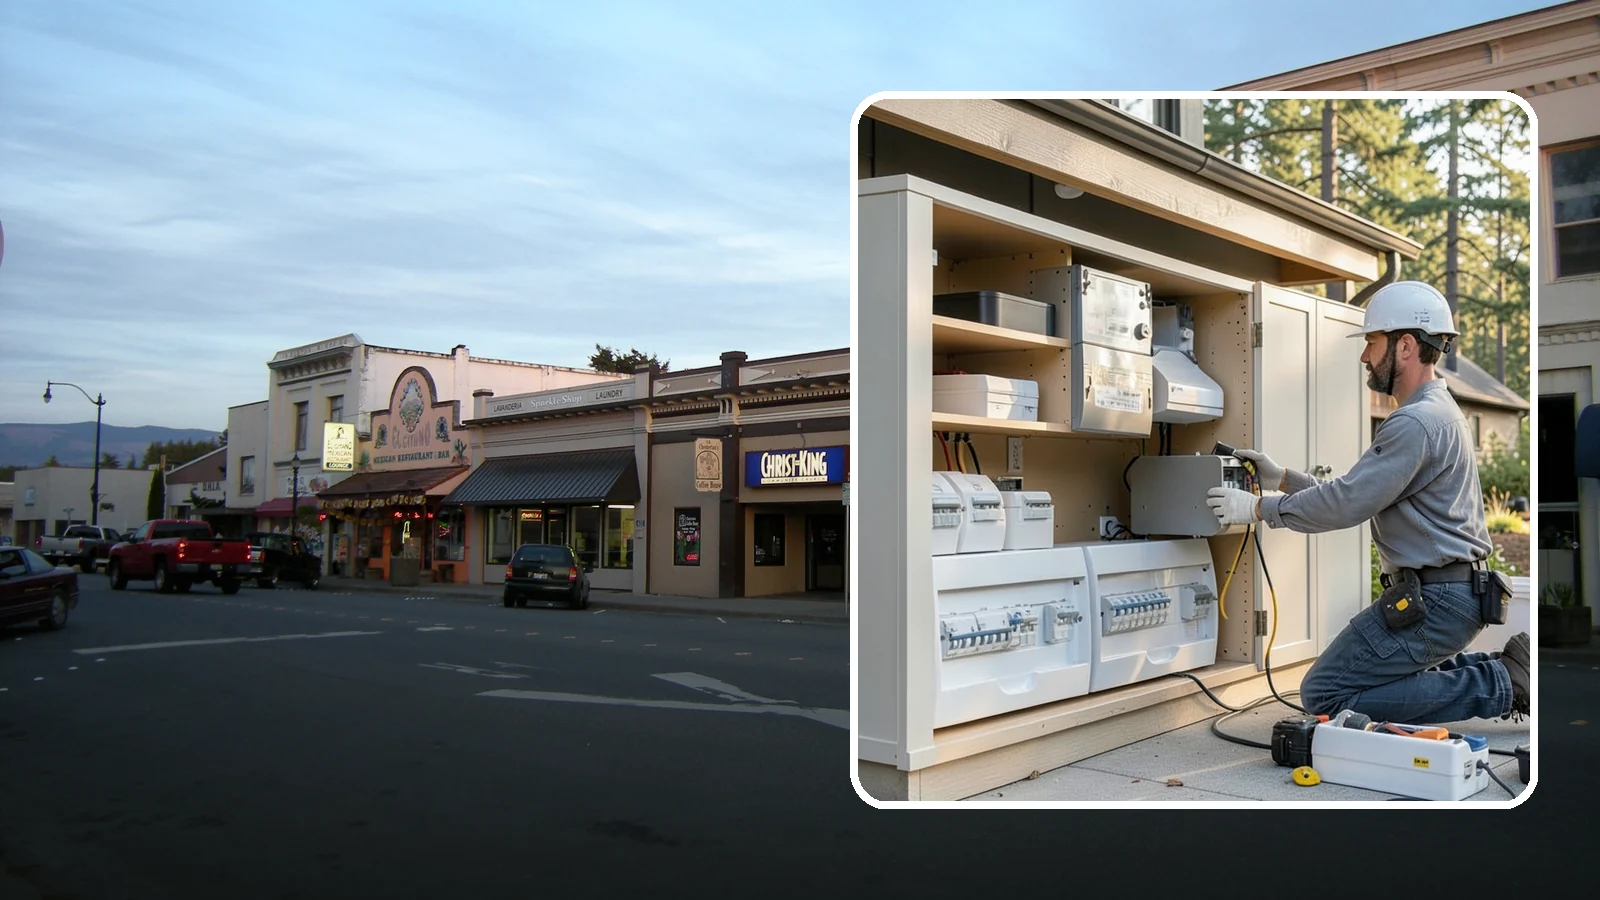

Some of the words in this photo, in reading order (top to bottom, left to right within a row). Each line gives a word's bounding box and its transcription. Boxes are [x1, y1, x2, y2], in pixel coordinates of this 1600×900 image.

[595, 388, 623, 400] LAUNDRY
[493, 401, 522, 413] LAVANDERIA
[531, 398, 561, 409] Sparkle
[562, 394, 583, 404] Shop
[373, 455, 396, 464] MEXICAN
[397, 451, 434, 462] RESTAURANT
[438, 449, 450, 459] BAR
[760, 452, 798, 478] CHRIST
[799, 450, 828, 476] KING
[696, 480, 709, 489] Coffee
[709, 480, 722, 489] House
